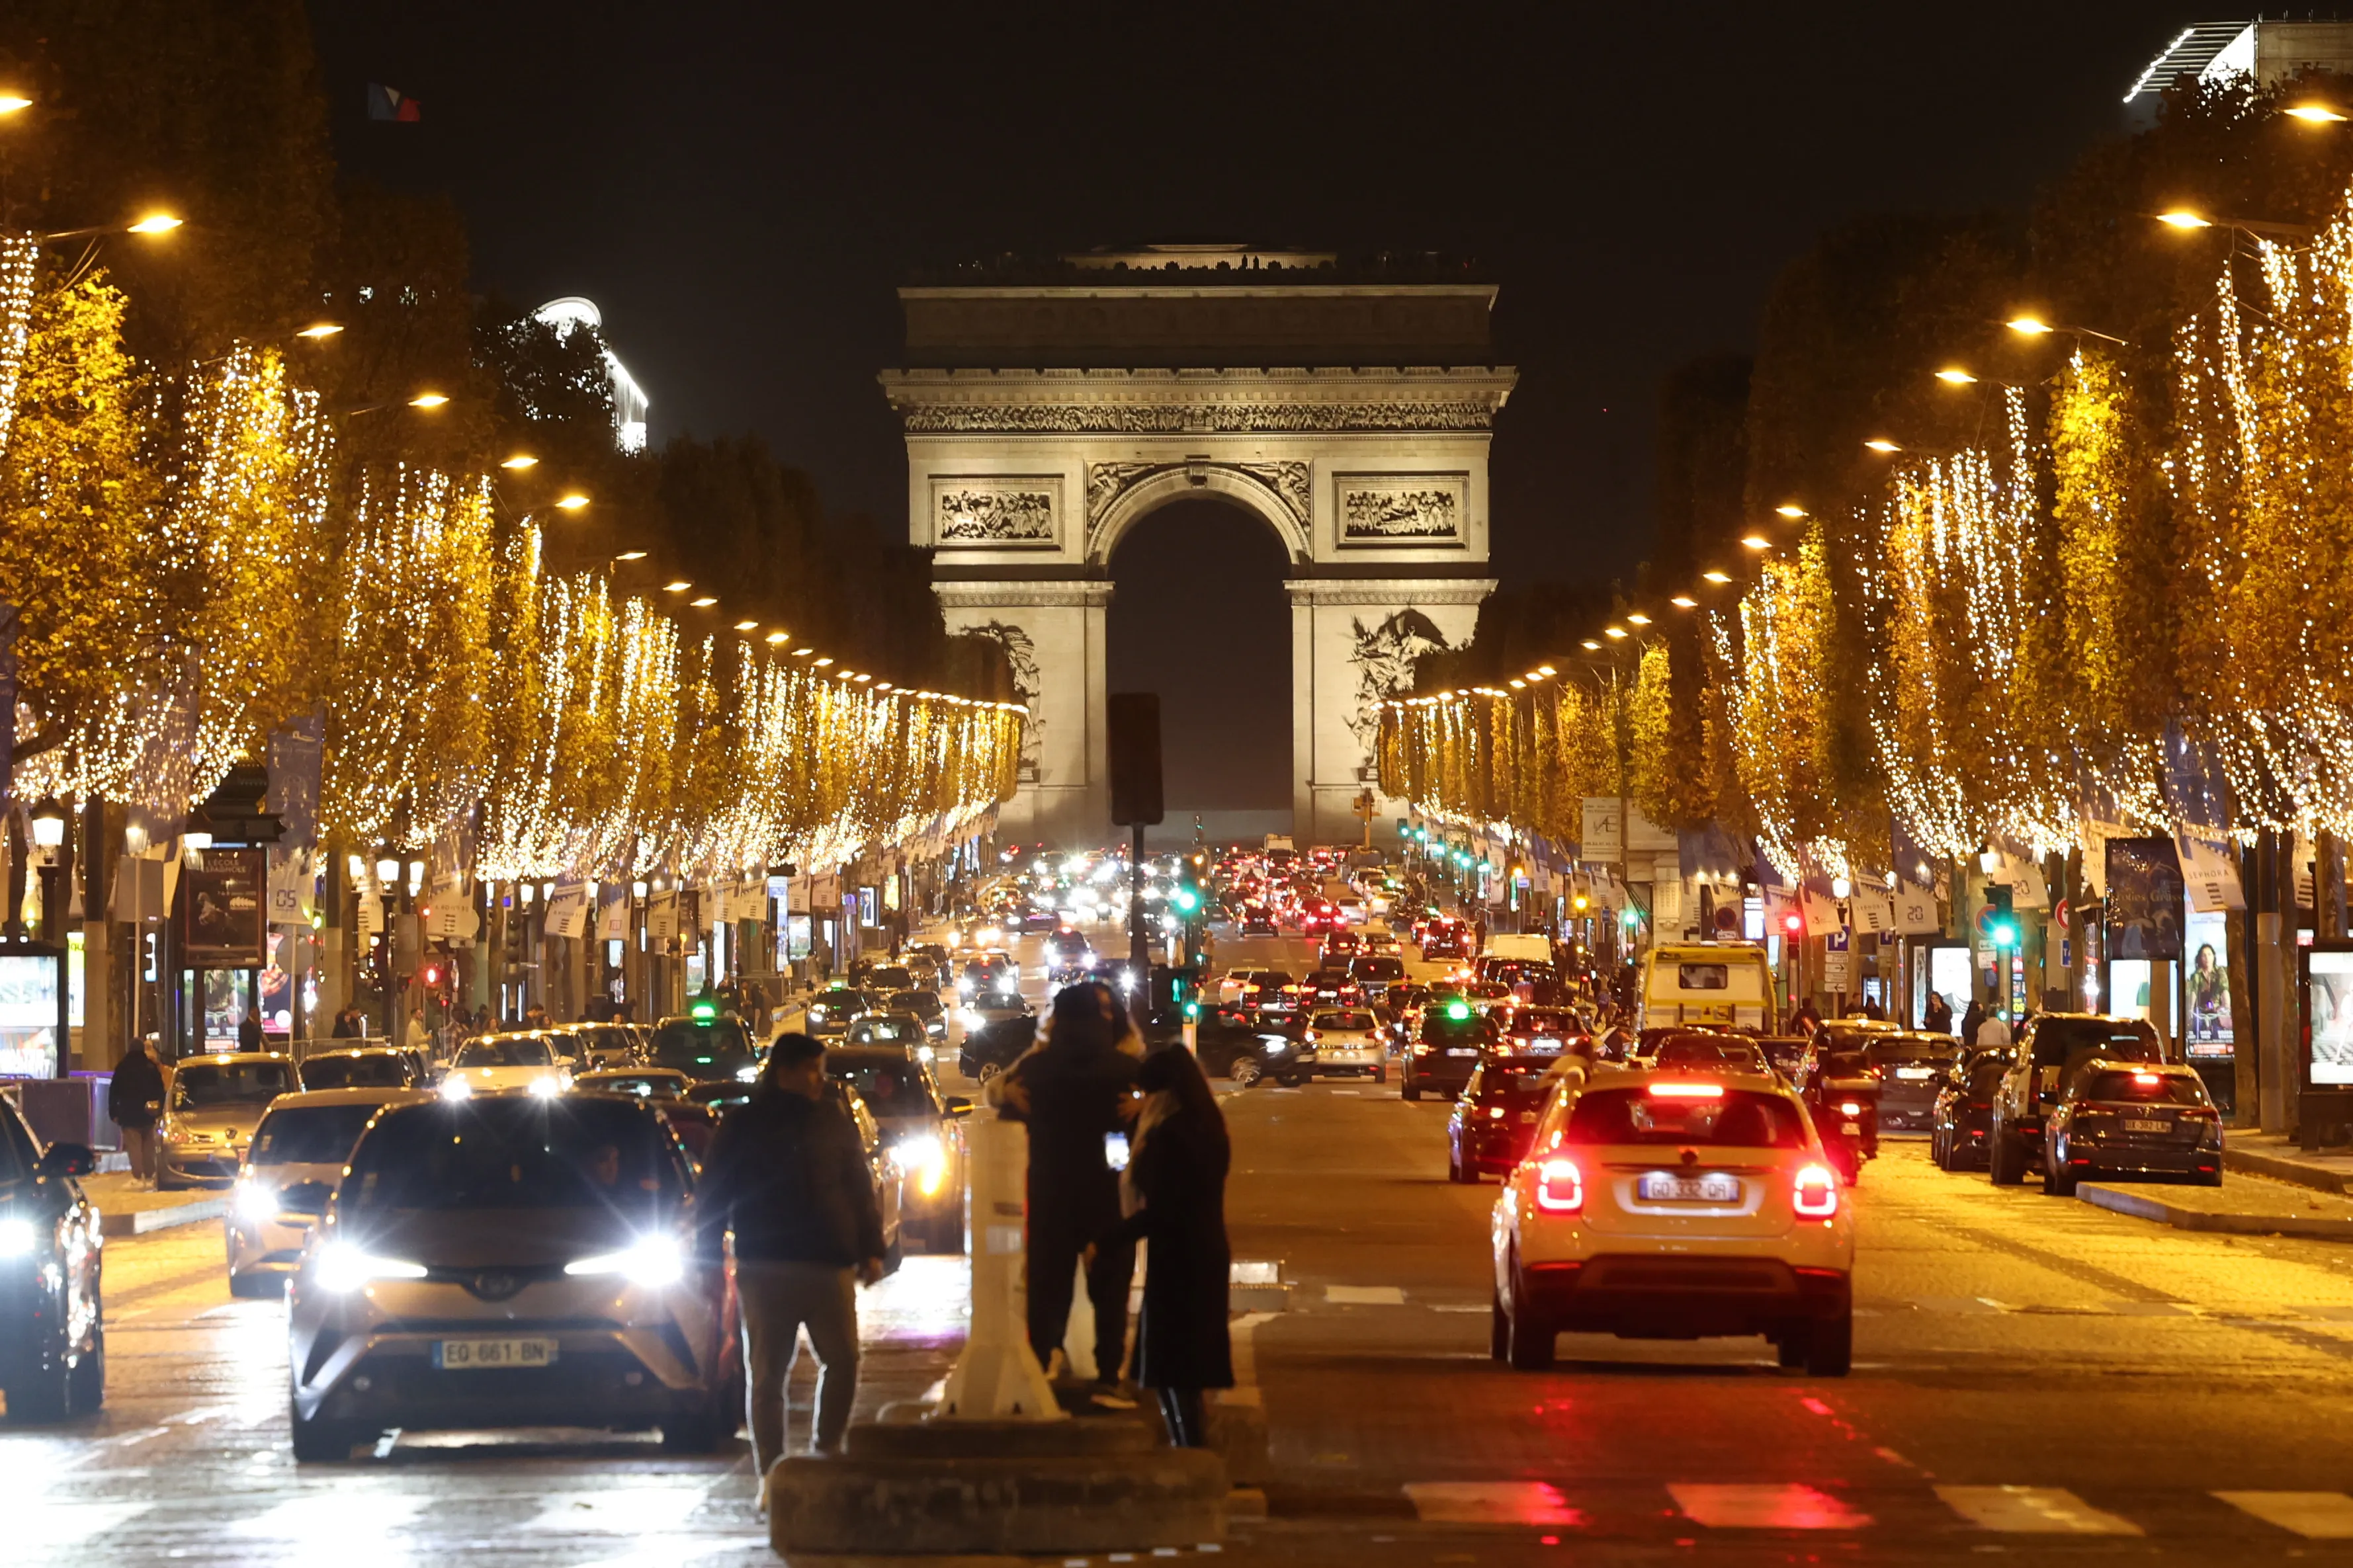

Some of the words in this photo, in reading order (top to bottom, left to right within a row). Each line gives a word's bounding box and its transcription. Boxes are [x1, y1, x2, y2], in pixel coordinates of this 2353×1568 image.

[2188, 868, 2229, 880] SEPHORA
[1907, 905, 1924, 921] 20
[1834, 929, 1847, 948] P
